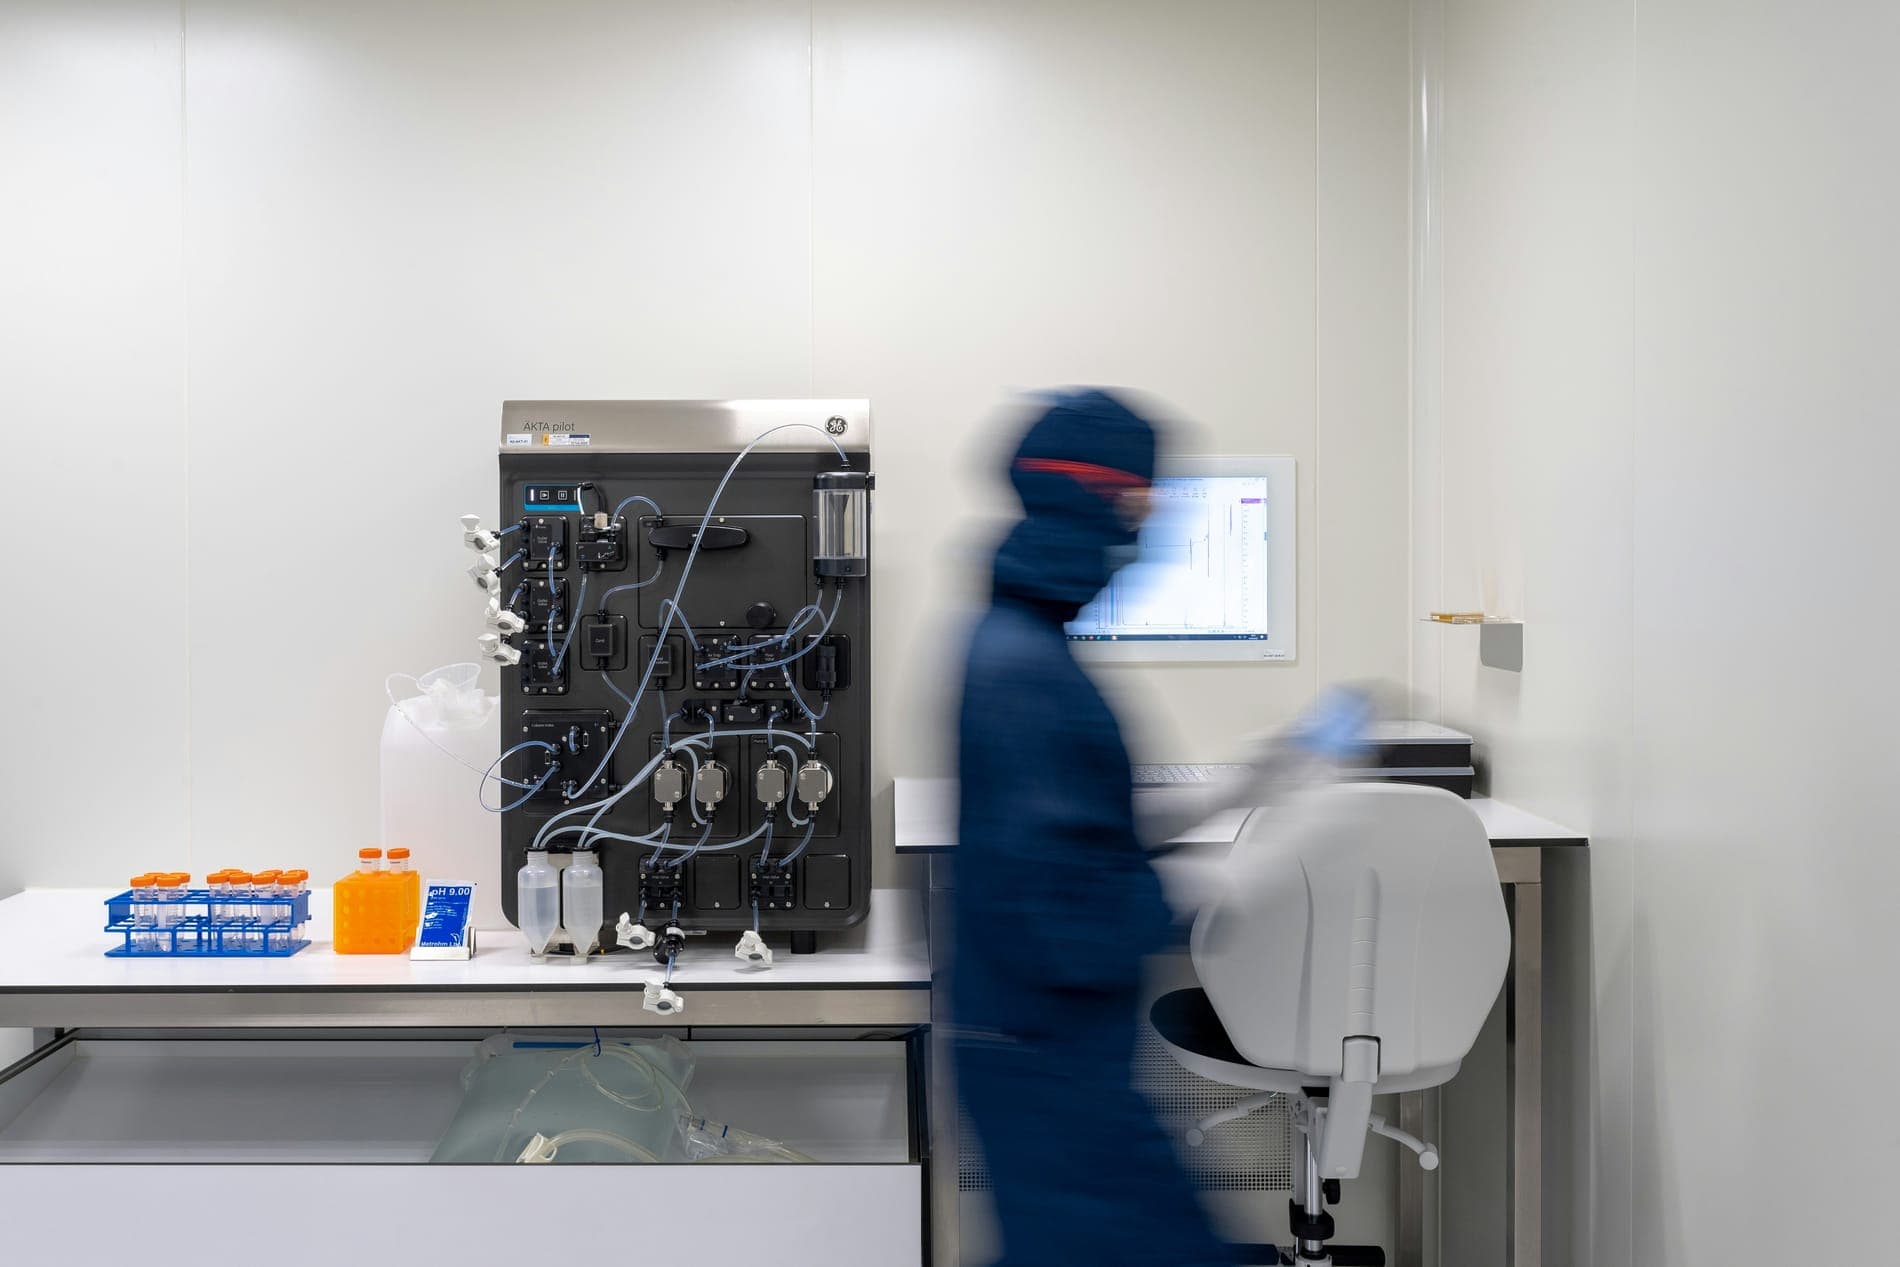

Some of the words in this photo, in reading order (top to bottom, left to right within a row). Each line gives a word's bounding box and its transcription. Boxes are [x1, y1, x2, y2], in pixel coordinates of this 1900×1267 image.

[552, 421, 575, 433] pilot
[432, 888, 447, 897] pH
[449, 888, 470, 896] 9.00
